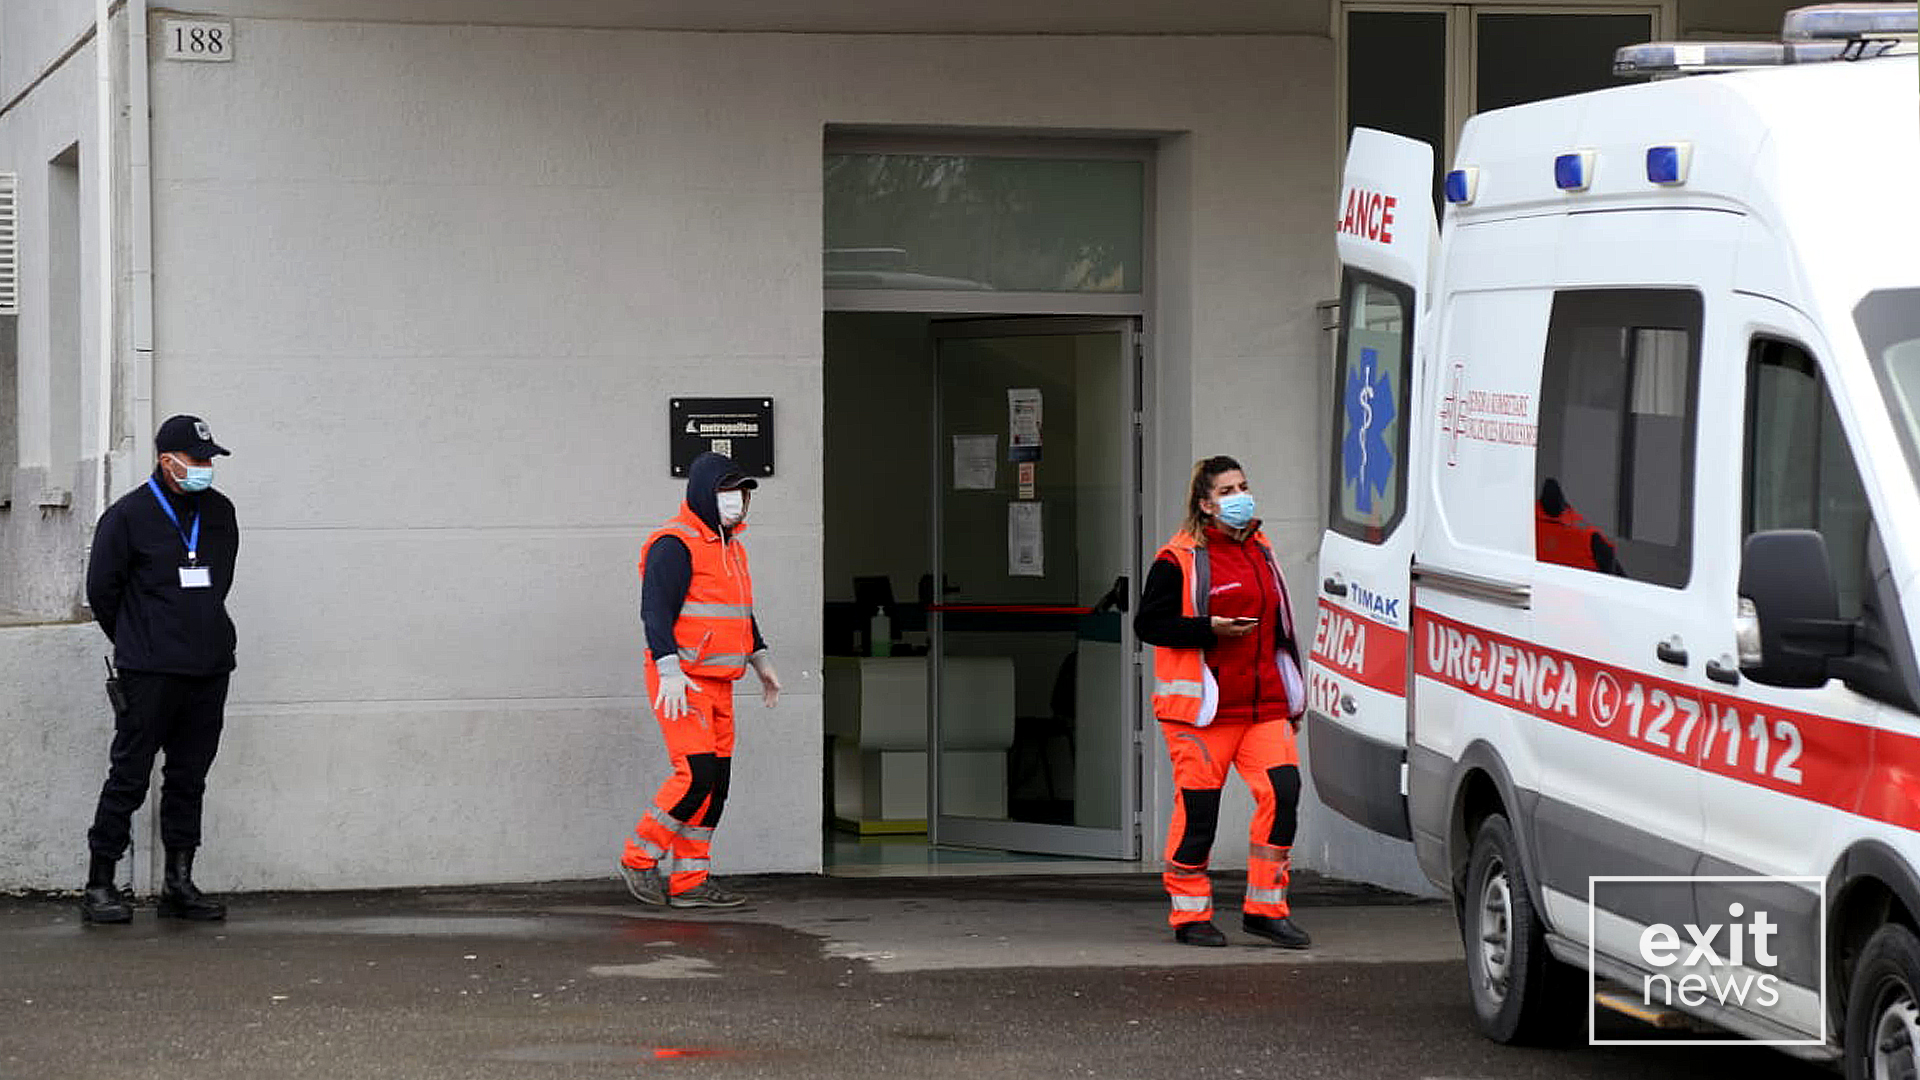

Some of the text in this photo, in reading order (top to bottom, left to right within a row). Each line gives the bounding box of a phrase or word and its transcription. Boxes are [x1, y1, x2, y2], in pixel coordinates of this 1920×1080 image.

[174, 27, 223, 54] 188
[1351, 582, 1399, 619] TIMAK
[1312, 607, 1366, 674] ENCA
[1427, 620, 1803, 785] URGJENCA 127/112
